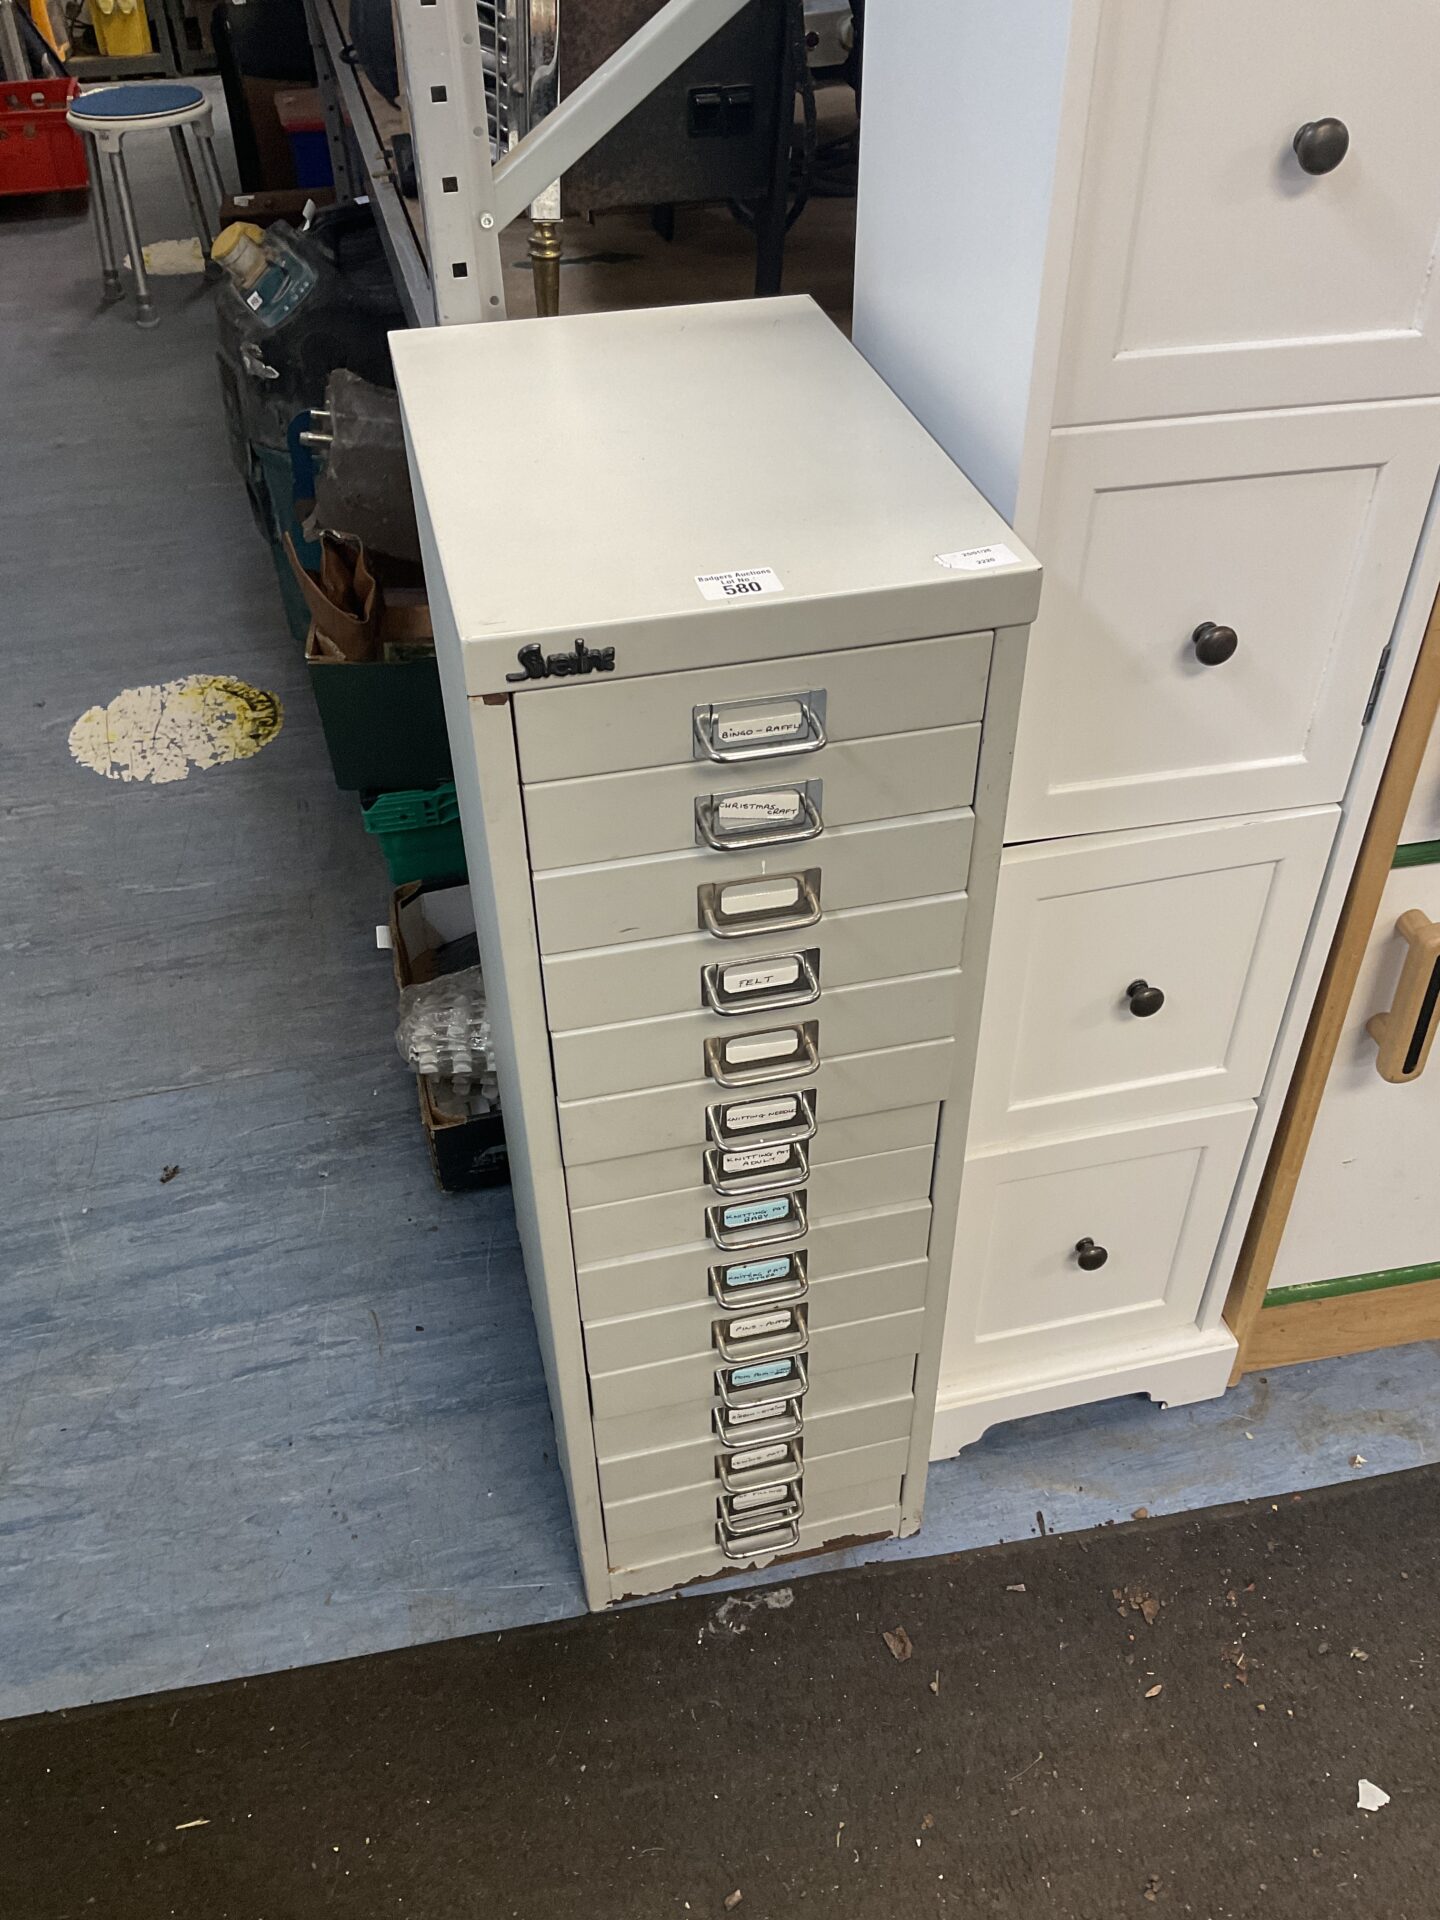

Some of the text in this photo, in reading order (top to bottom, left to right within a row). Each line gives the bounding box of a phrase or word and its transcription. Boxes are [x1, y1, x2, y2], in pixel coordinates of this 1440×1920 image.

[697, 569, 772, 583] Badgers Auctions
[723, 581, 762, 596] 580
[739, 975, 773, 988] FELT
[726, 1152, 773, 1162] KNITTING
[742, 1157, 775, 1166] ADULT
[725, 1210, 767, 1220] KNITTING
[743, 1213, 769, 1223] BABY
